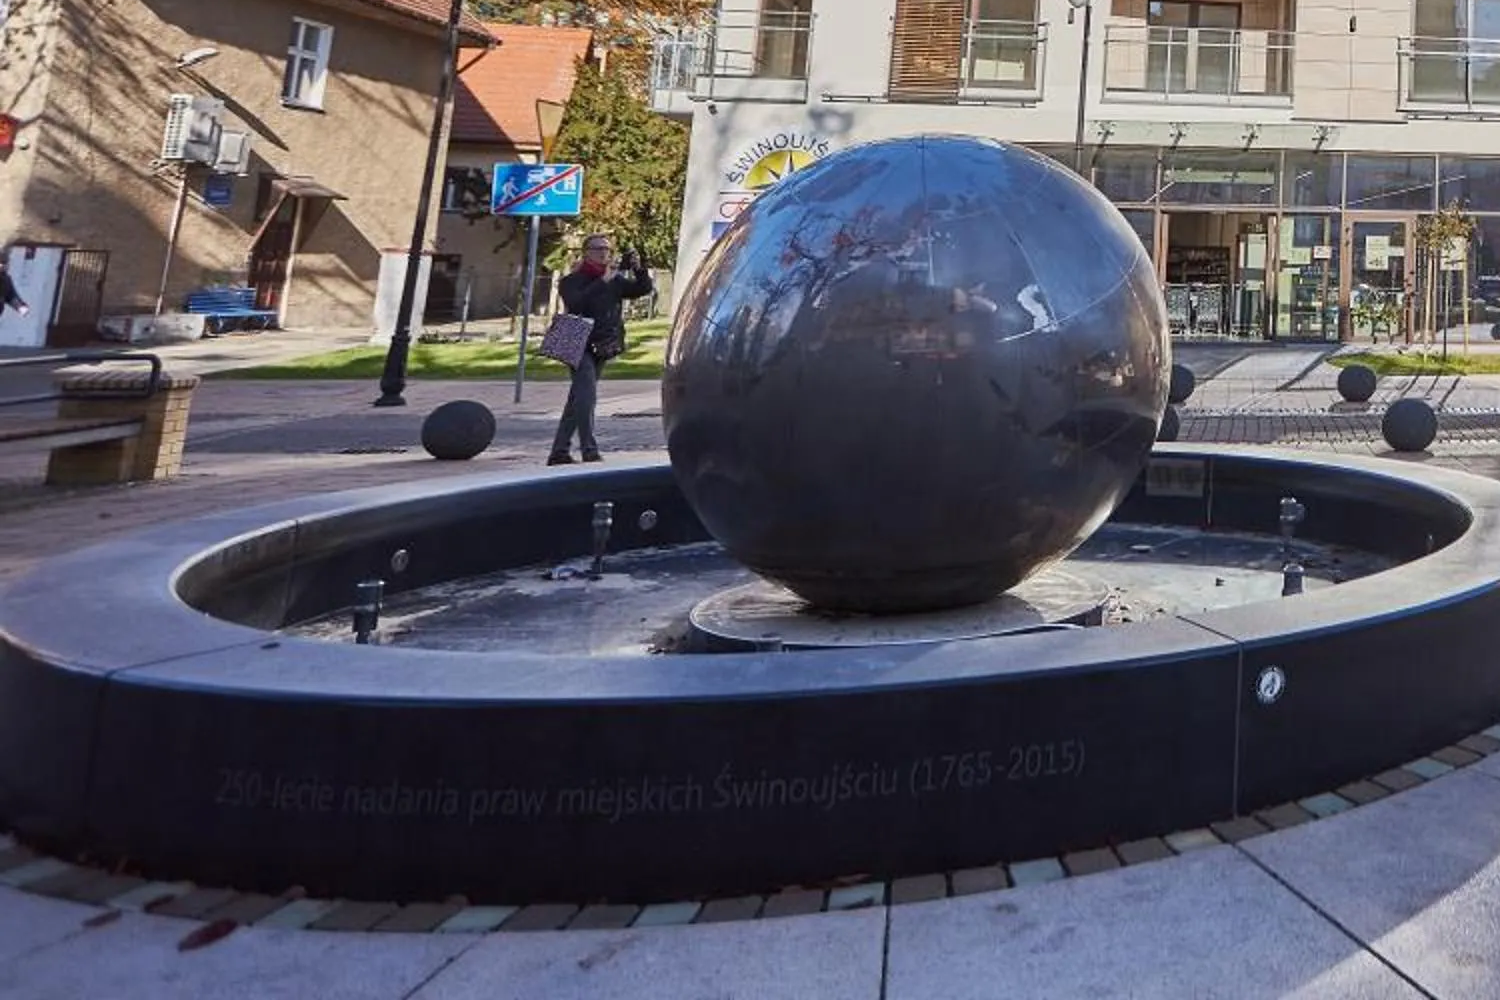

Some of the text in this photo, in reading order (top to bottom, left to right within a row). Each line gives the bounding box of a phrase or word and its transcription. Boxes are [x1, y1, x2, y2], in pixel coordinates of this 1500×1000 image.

[725, 133, 829, 185] ŚWINOUJŚ
[215, 738, 1086, 826] 250-lecie nadania praw miejskich Świnoujściu (1765-2015)
